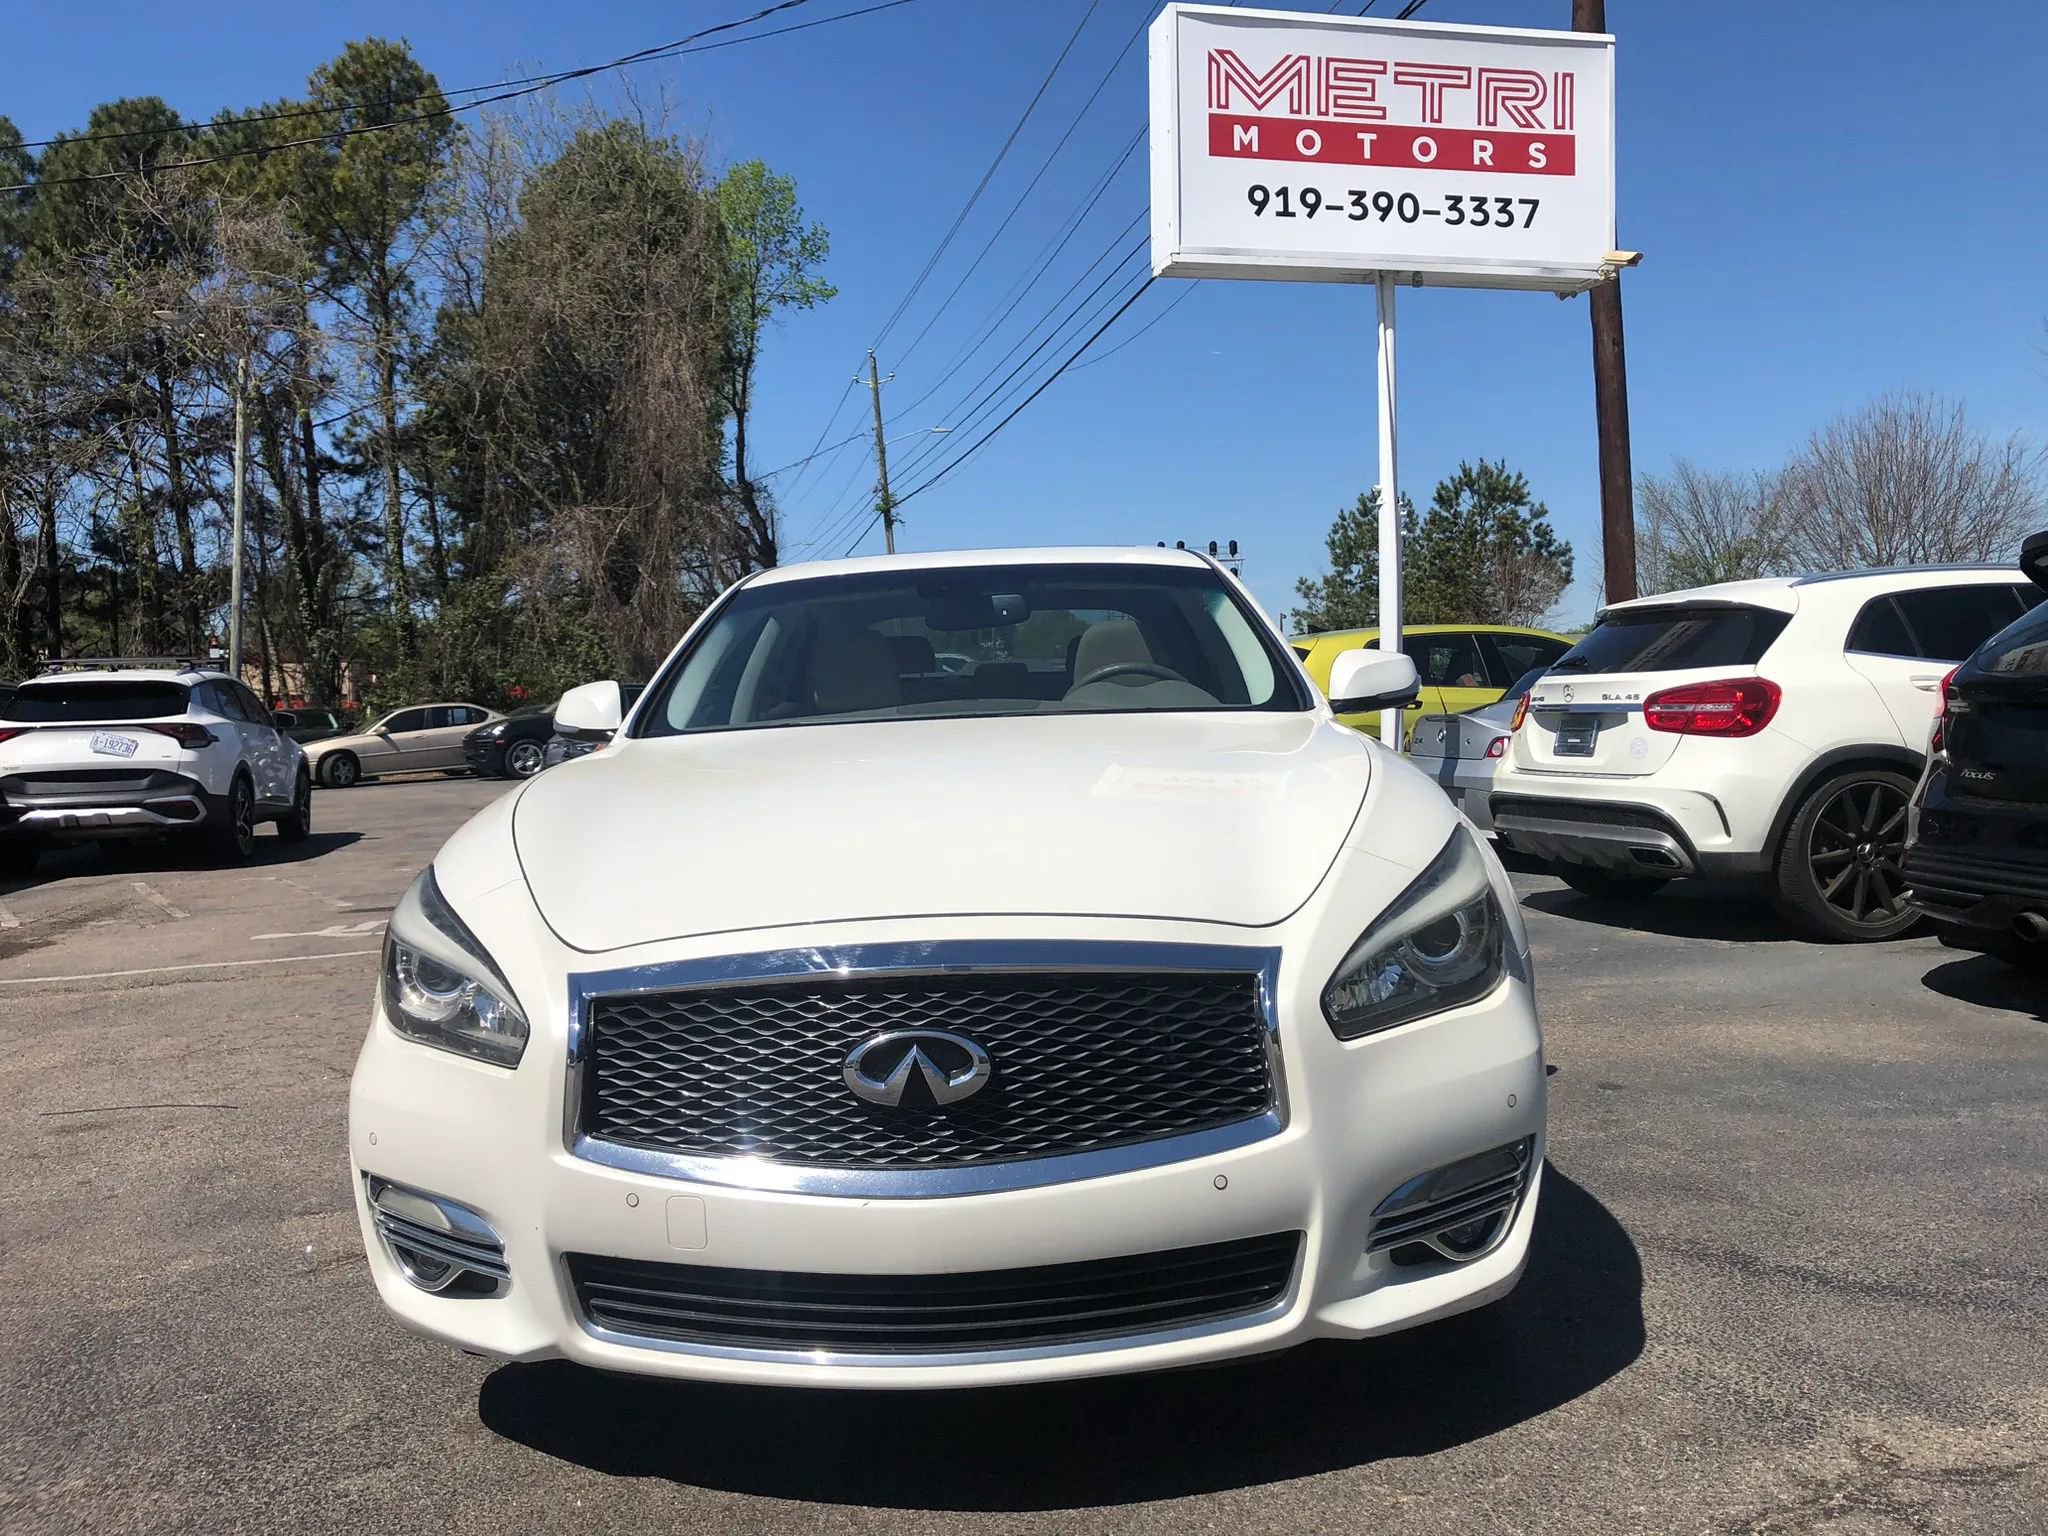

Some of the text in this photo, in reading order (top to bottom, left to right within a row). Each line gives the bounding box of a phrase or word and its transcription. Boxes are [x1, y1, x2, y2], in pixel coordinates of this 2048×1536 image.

[1208, 49, 1575, 130] METRI
[1233, 124, 1547, 169] MOTORS
[1247, 184, 1540, 229] 919-390-3337
[1601, 693, 1641, 701] GLA 45
